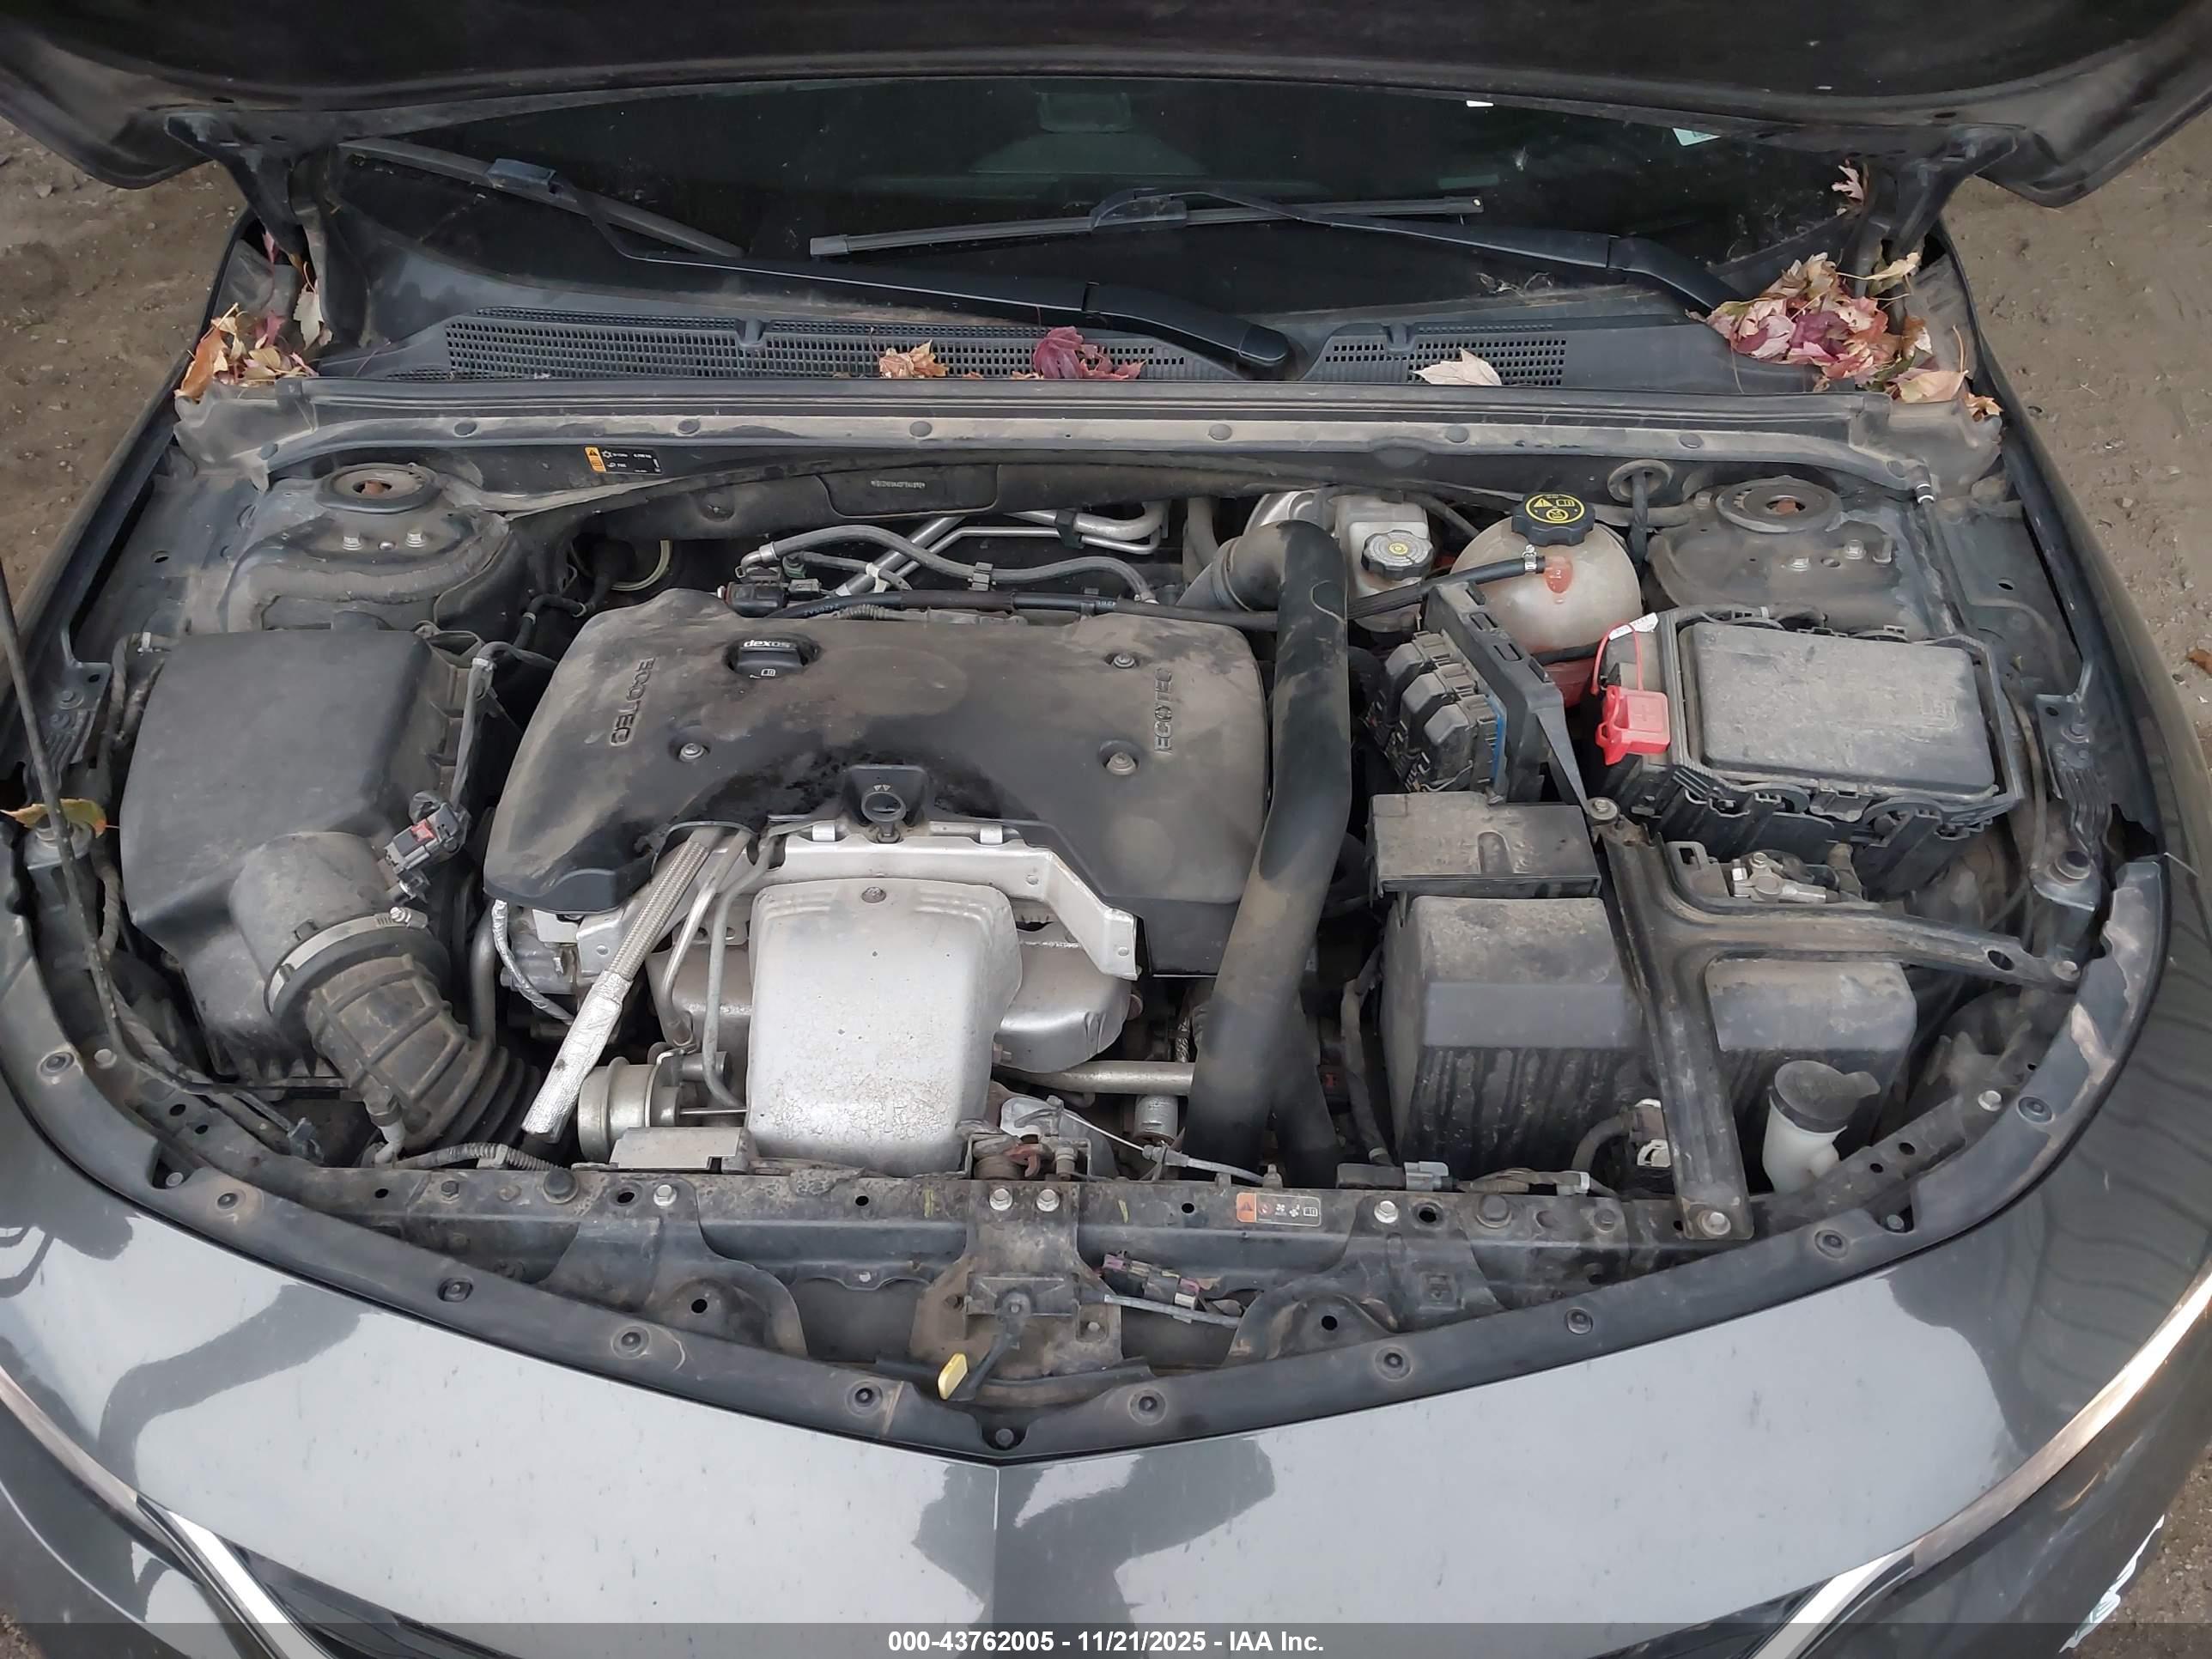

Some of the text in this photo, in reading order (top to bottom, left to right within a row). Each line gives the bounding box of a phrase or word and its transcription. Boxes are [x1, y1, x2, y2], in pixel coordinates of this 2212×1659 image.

[744, 640, 791, 648] dexos
[611, 658, 655, 745] ECOTEC
[1154, 667, 1173, 753] ECOTEC
